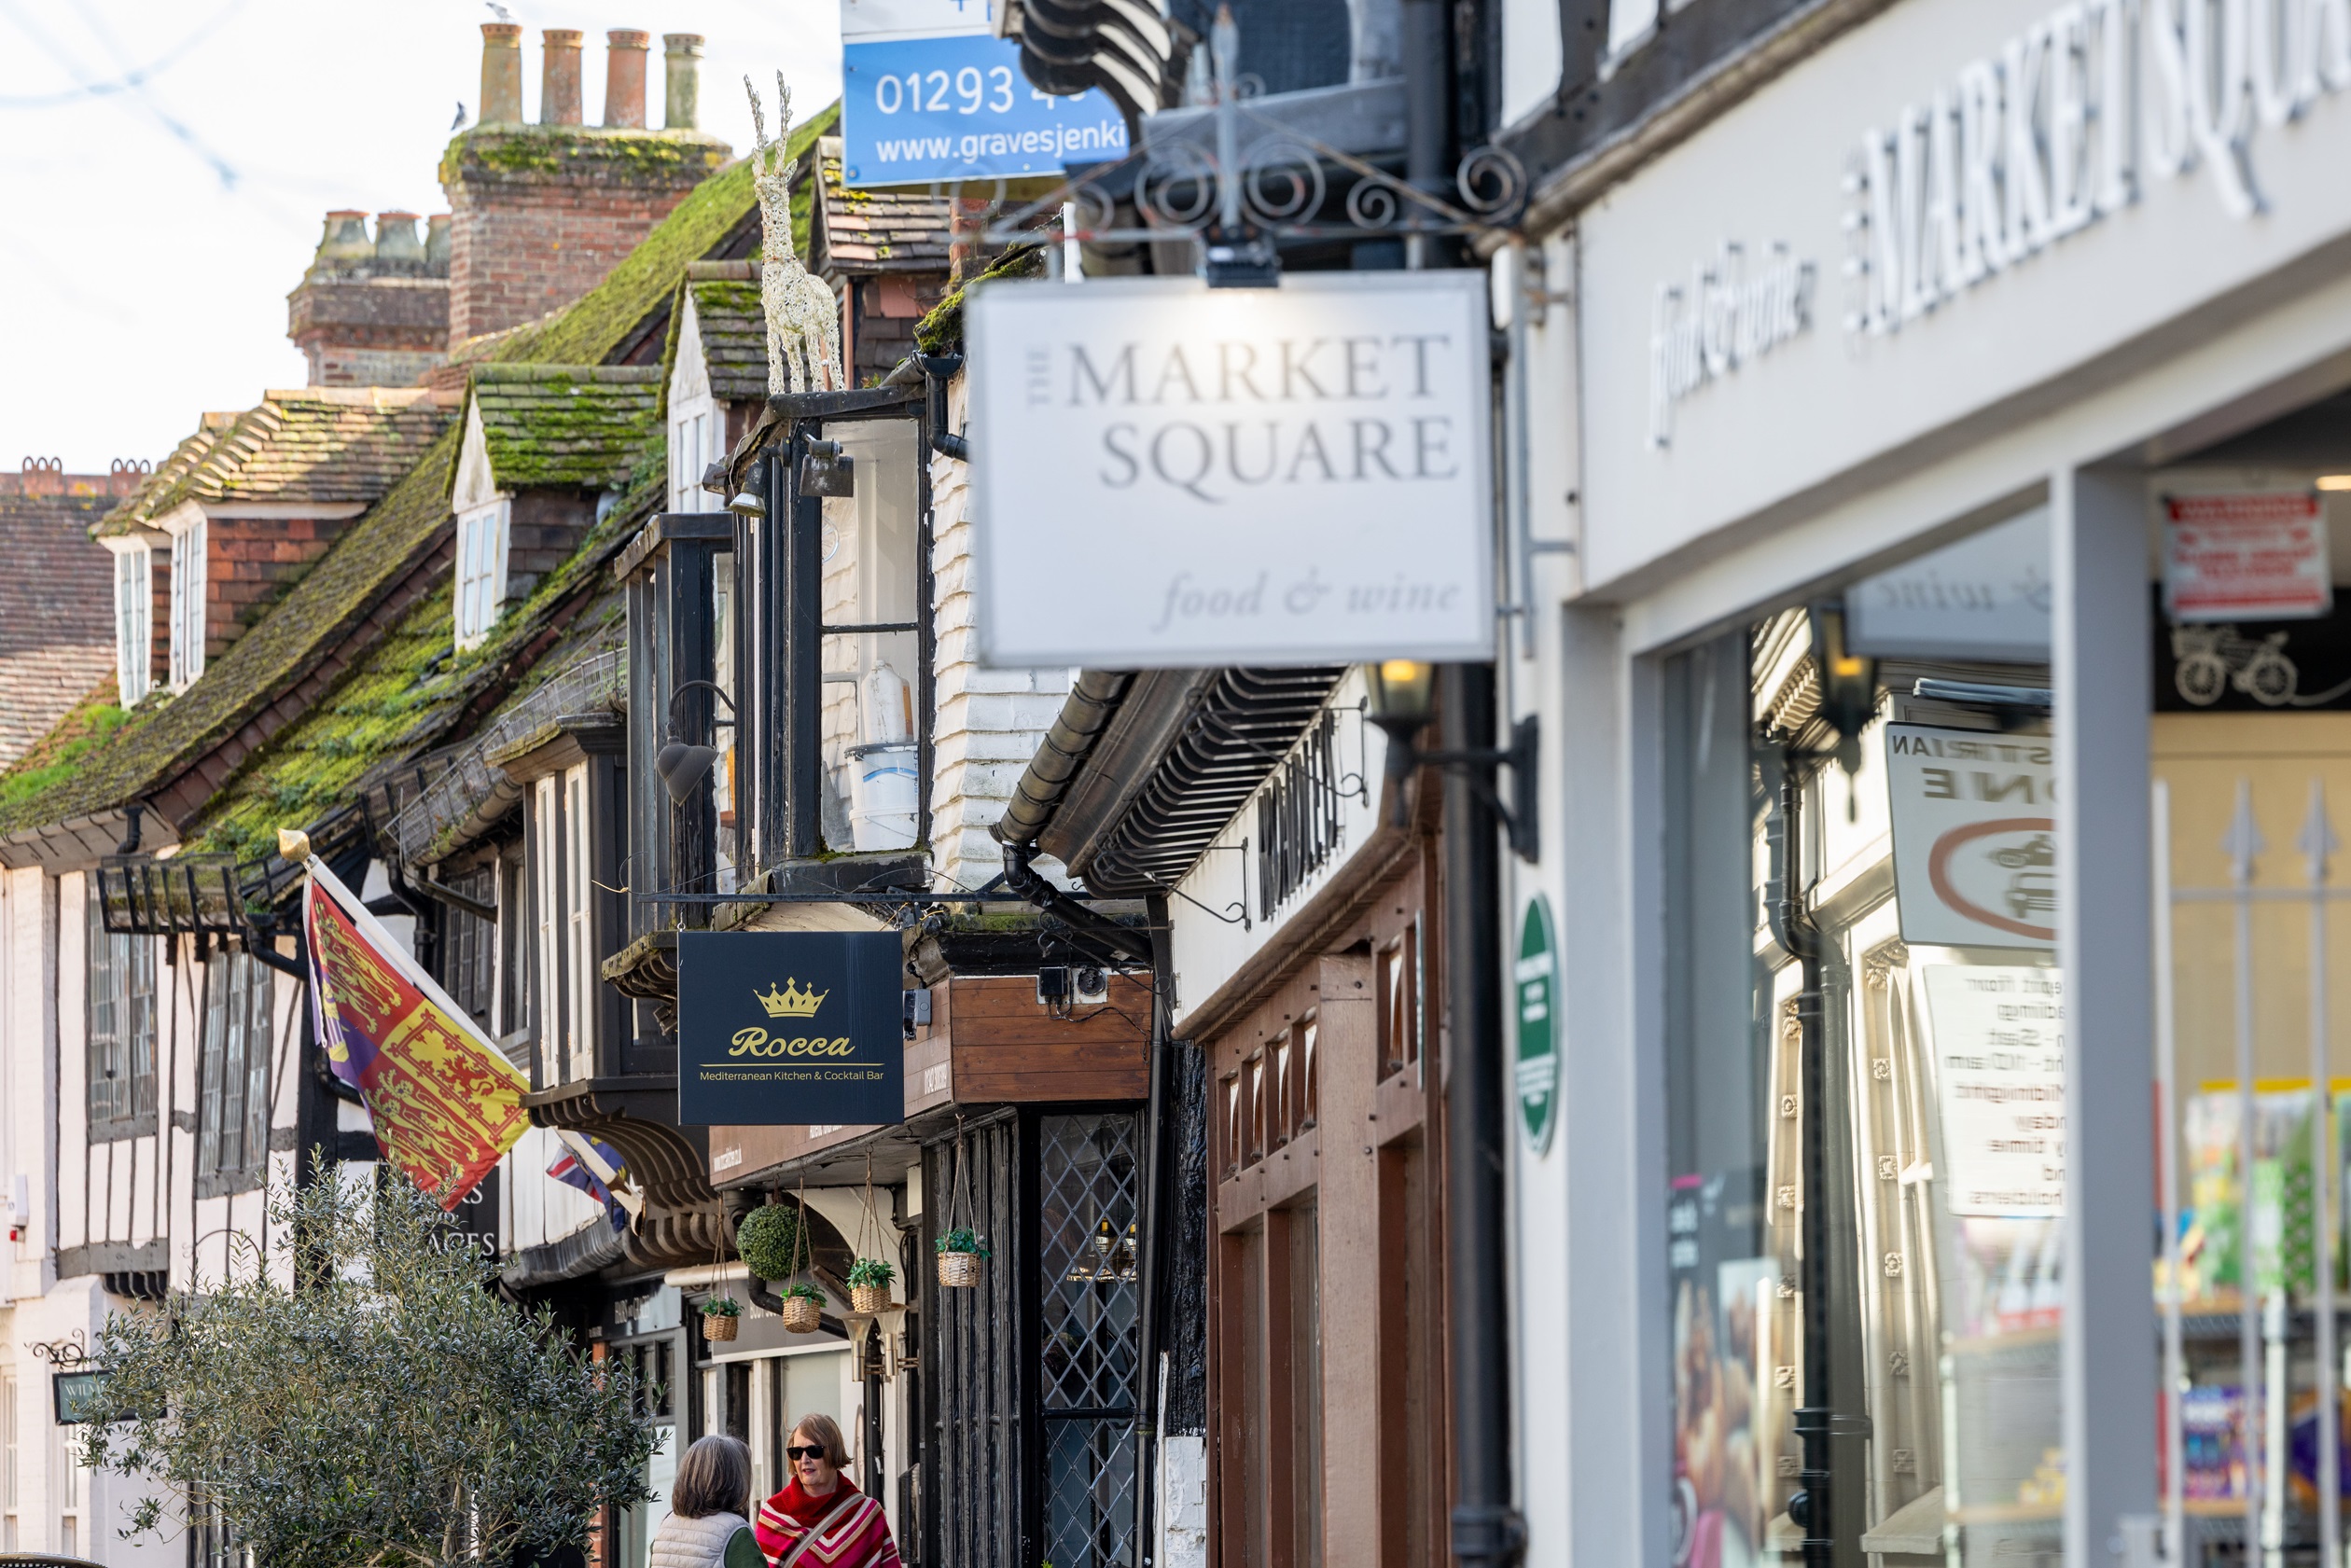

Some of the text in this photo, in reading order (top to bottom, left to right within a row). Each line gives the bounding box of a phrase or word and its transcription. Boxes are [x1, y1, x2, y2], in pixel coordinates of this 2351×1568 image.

[875, 66, 1014, 115] 01293
[1064, 333, 1451, 408] MARKET
[1098, 416, 1459, 506] SQUARE
[1150, 564, 1461, 634] food & wine
[728, 1026, 856, 1057] Rocca
[700, 1070, 883, 1081] Mediterranean Kitchen & Cocktail Bar
